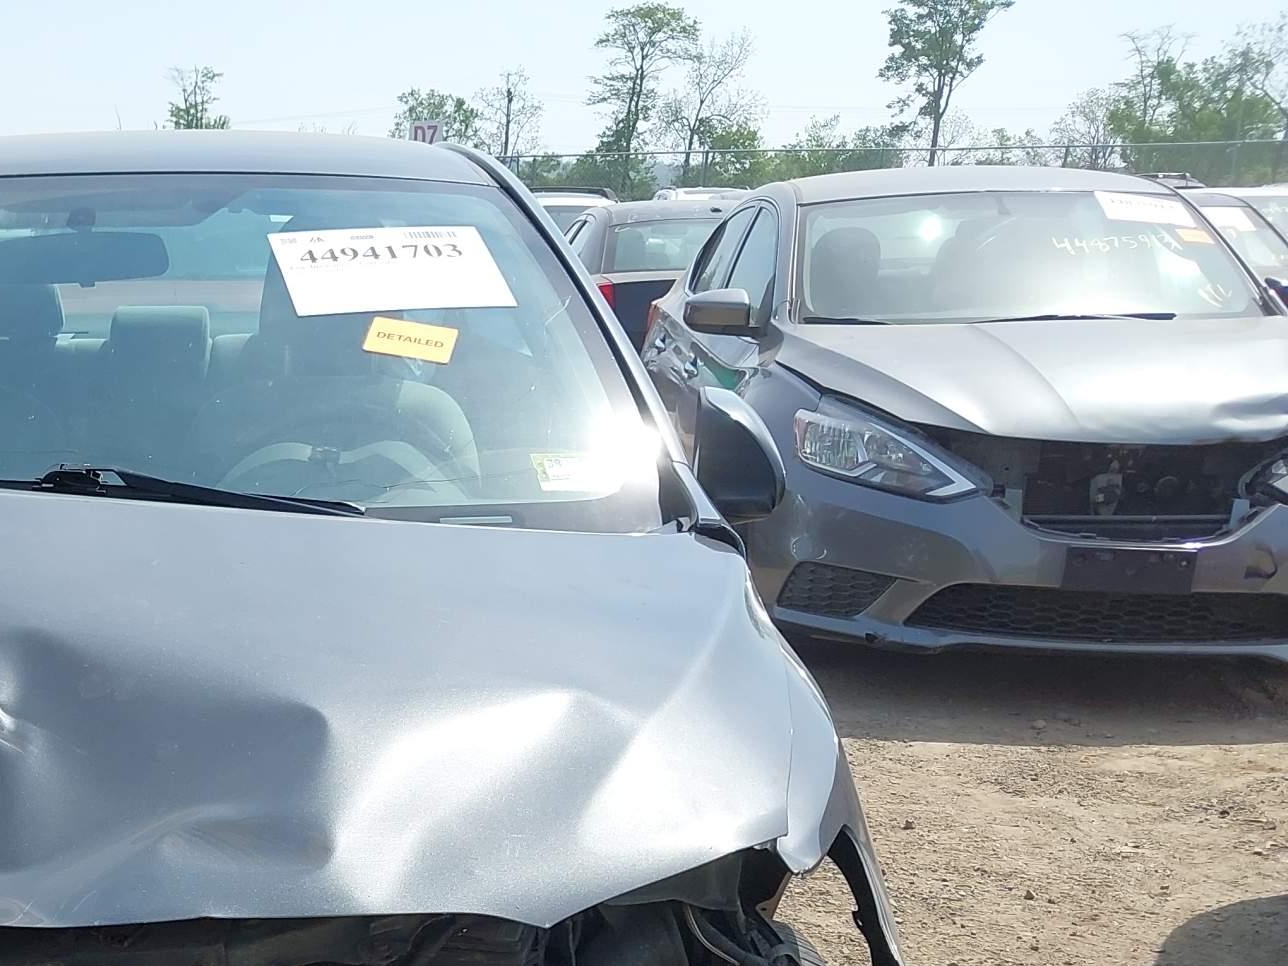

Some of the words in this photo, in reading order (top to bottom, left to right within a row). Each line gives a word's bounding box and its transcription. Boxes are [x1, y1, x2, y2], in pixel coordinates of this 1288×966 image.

[414, 125, 438, 145] D7
[300, 243, 463, 263] 44941703
[376, 331, 444, 348] DETAILED
